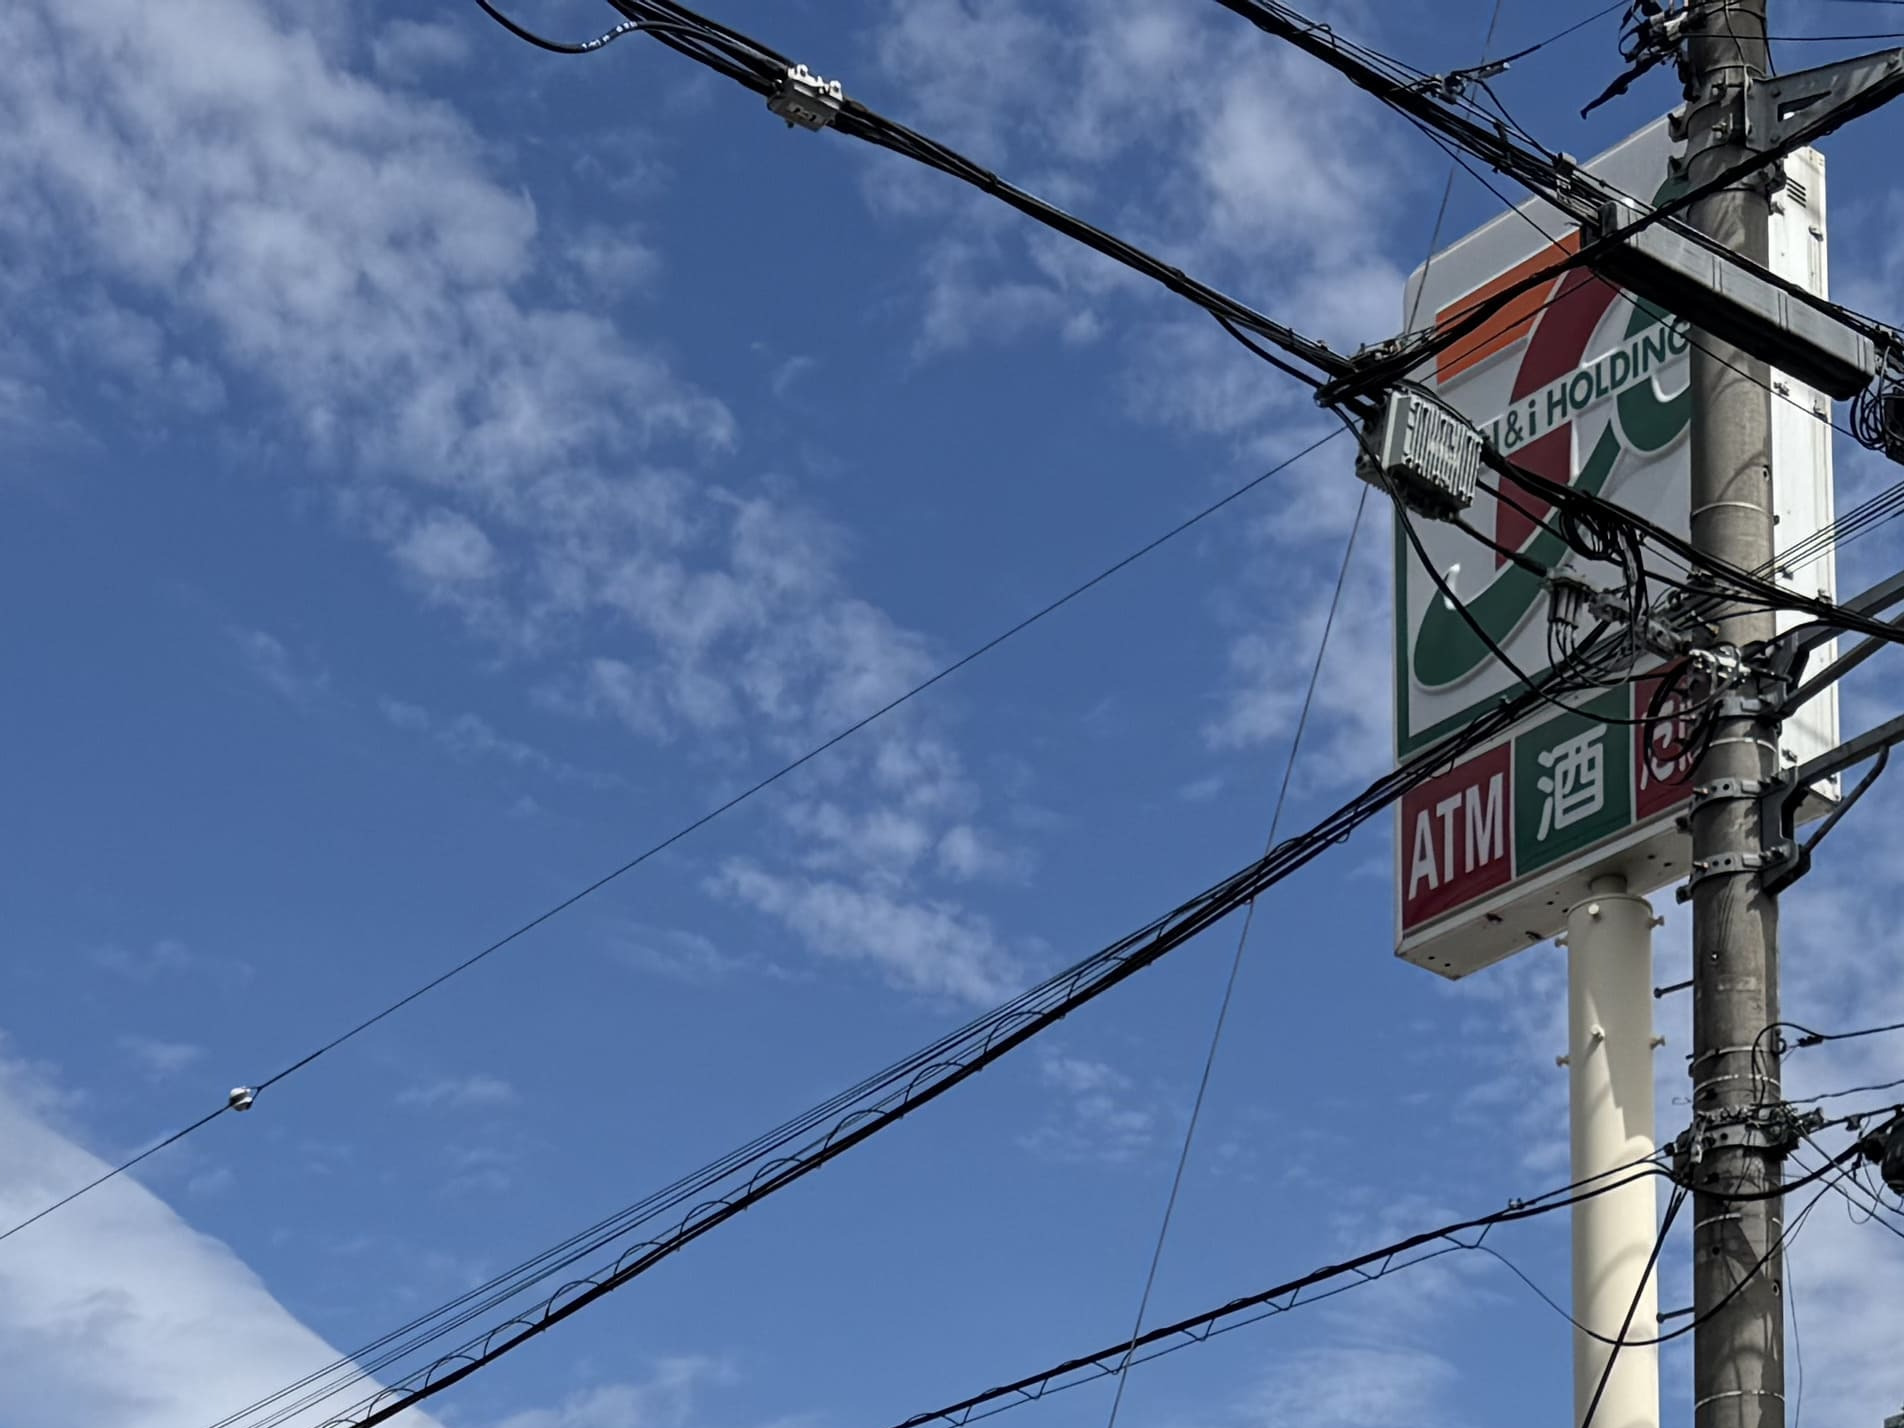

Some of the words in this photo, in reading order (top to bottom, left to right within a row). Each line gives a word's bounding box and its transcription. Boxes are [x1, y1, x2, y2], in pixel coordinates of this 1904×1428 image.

[1547, 319, 1694, 427] HOLDING
[1408, 771, 1505, 901] ATM
[1535, 723, 1607, 841] 酒
